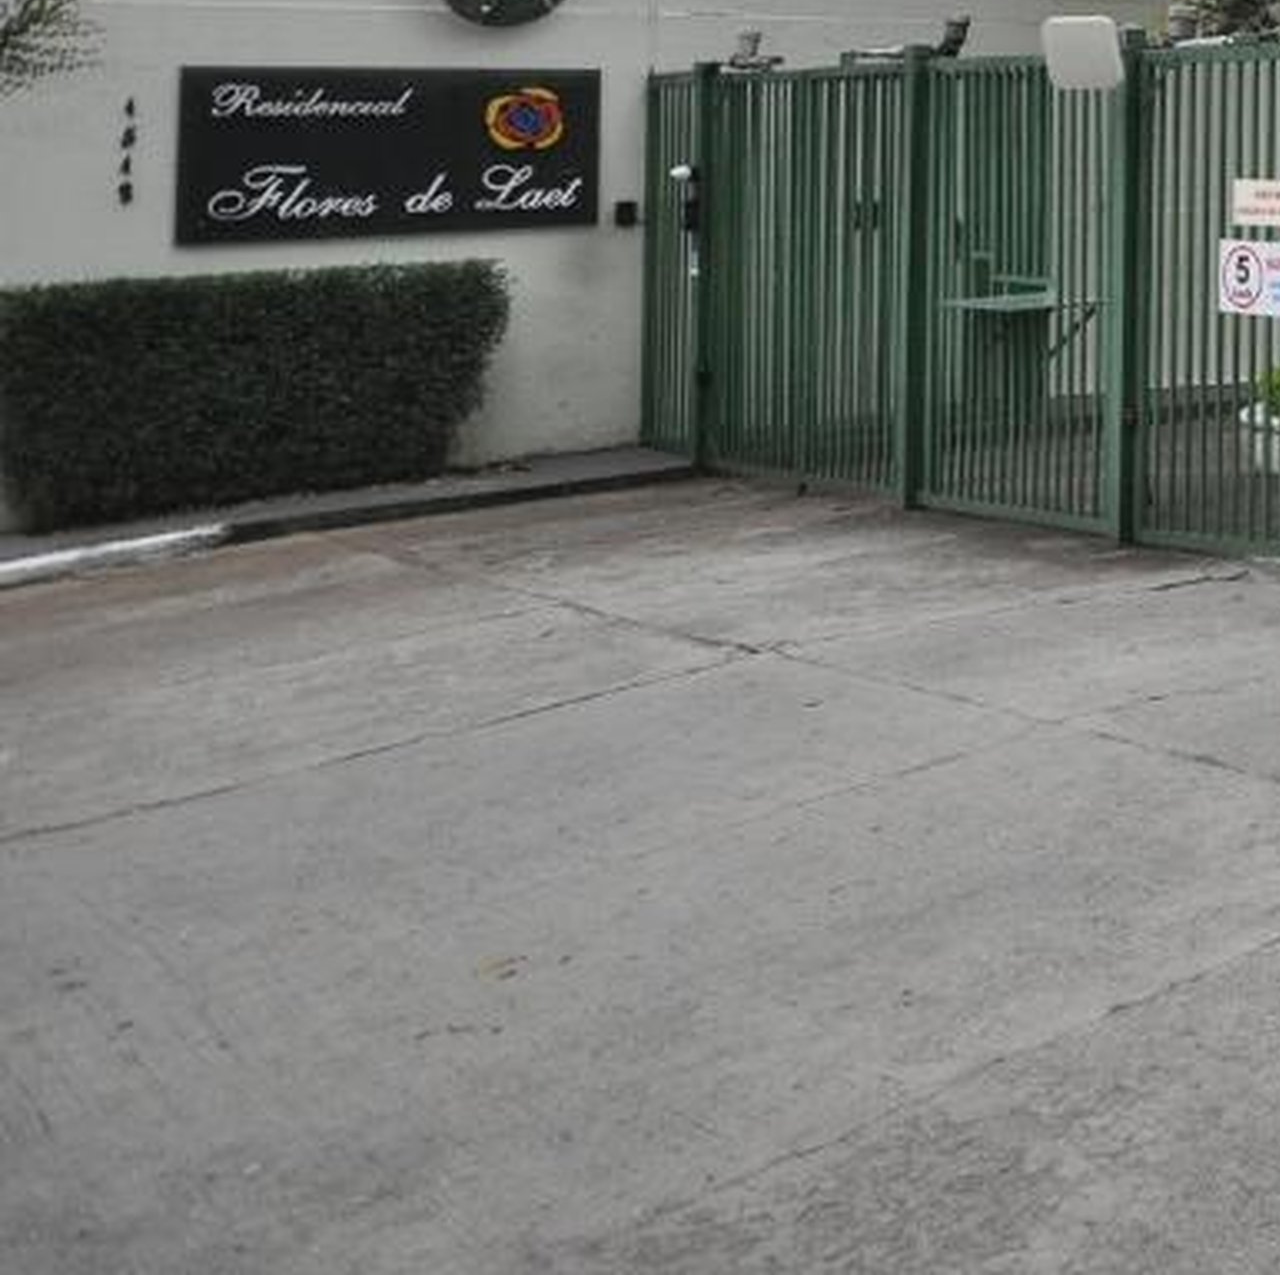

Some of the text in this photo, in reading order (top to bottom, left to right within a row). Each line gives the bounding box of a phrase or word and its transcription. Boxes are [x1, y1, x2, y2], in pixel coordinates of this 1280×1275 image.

[212, 82, 414, 117] Residencial
[207, 164, 583, 220] Flores de Laet
[1235, 255, 1250, 284] 5
